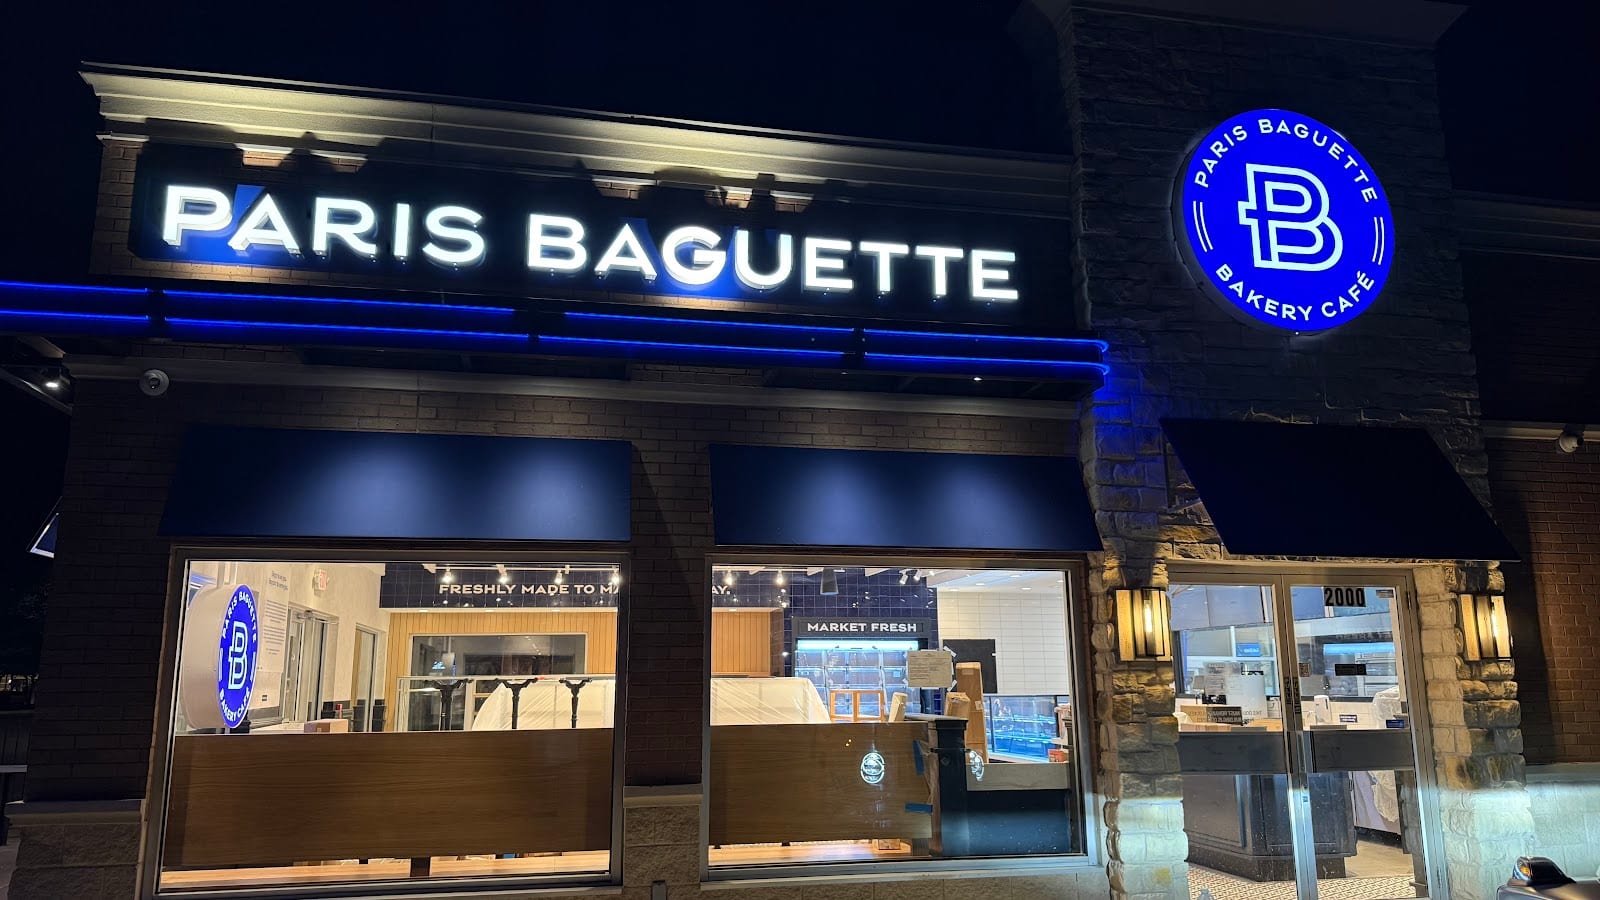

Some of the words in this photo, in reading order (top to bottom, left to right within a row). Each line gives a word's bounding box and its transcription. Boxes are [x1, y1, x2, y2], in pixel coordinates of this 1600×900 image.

[1194, 125, 1248, 188] PARIS
[1257, 118, 1378, 203] BAGUETTE
[162, 185, 486, 264] PARIS
[526, 213, 1020, 301] BAGUETTE
[1215, 263, 1313, 321] BAKERY
[1321, 270, 1375, 318] CAFÉ
[439, 584, 516, 595] FRESHLY
[521, 584, 570, 596] MADE
[574, 584, 595, 595] TO
[1323, 587, 1365, 607] 2000
[807, 622, 867, 632] MARKET
[870, 623, 917, 633] FRESH
